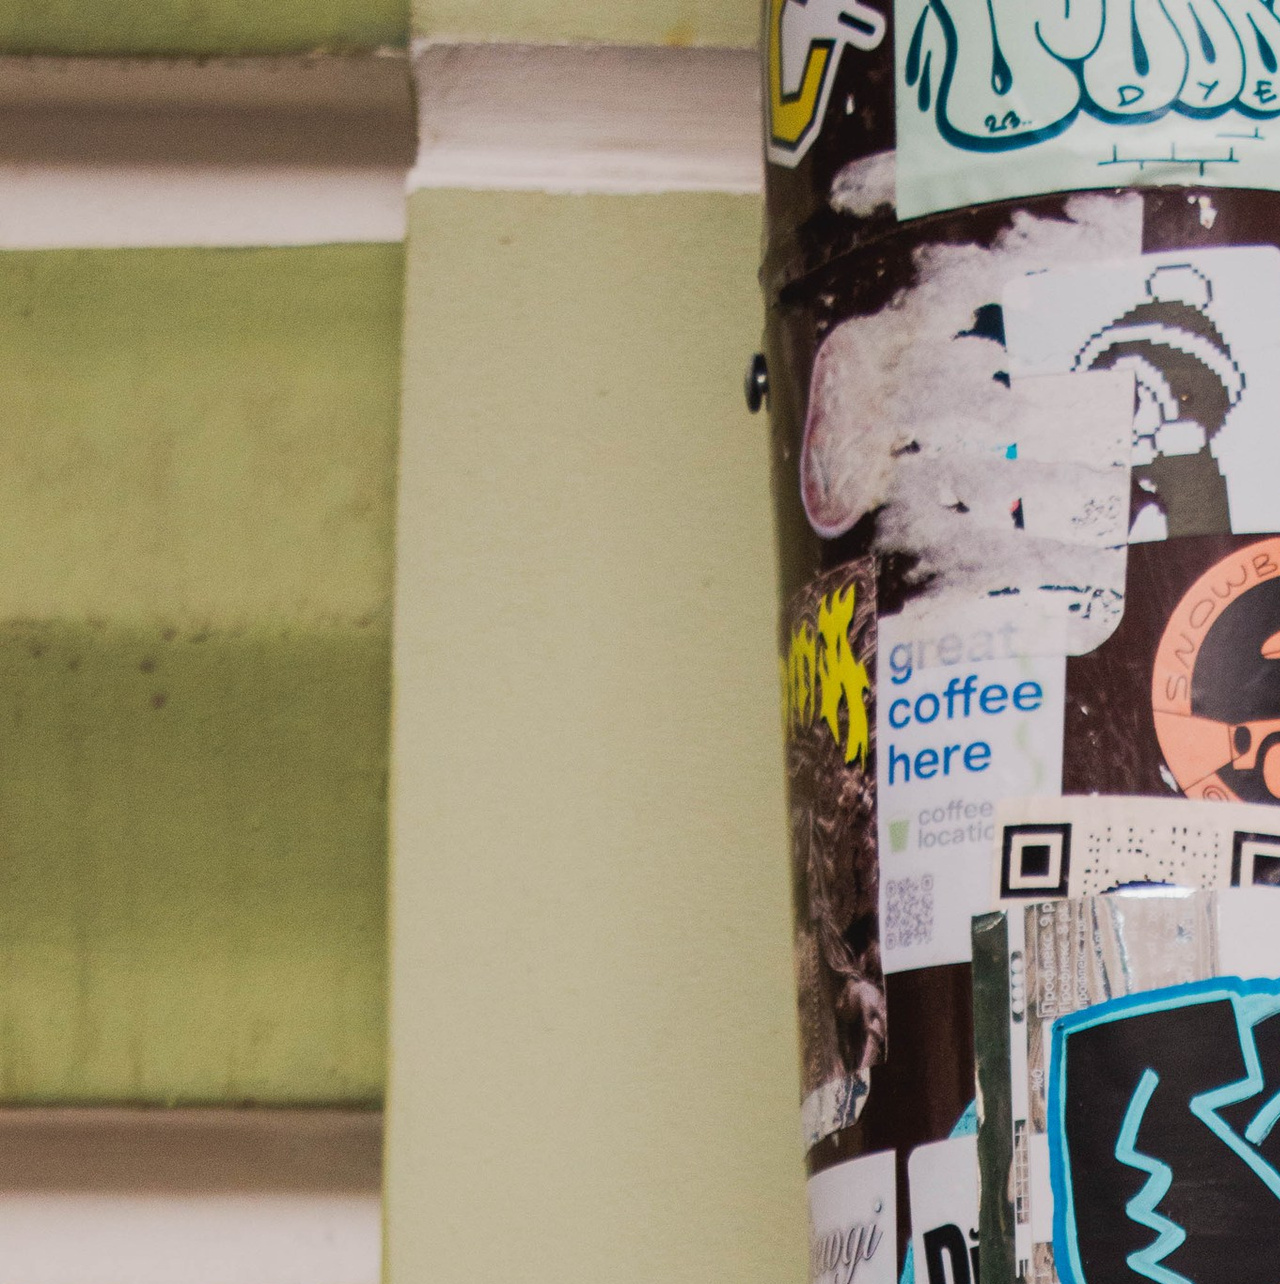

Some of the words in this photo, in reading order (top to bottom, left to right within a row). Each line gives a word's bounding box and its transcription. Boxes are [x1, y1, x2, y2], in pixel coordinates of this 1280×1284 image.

[888, 621, 1018, 686] great
[887, 674, 1043, 730] coffee
[887, 741, 992, 786] here
[917, 800, 994, 827] coffee
